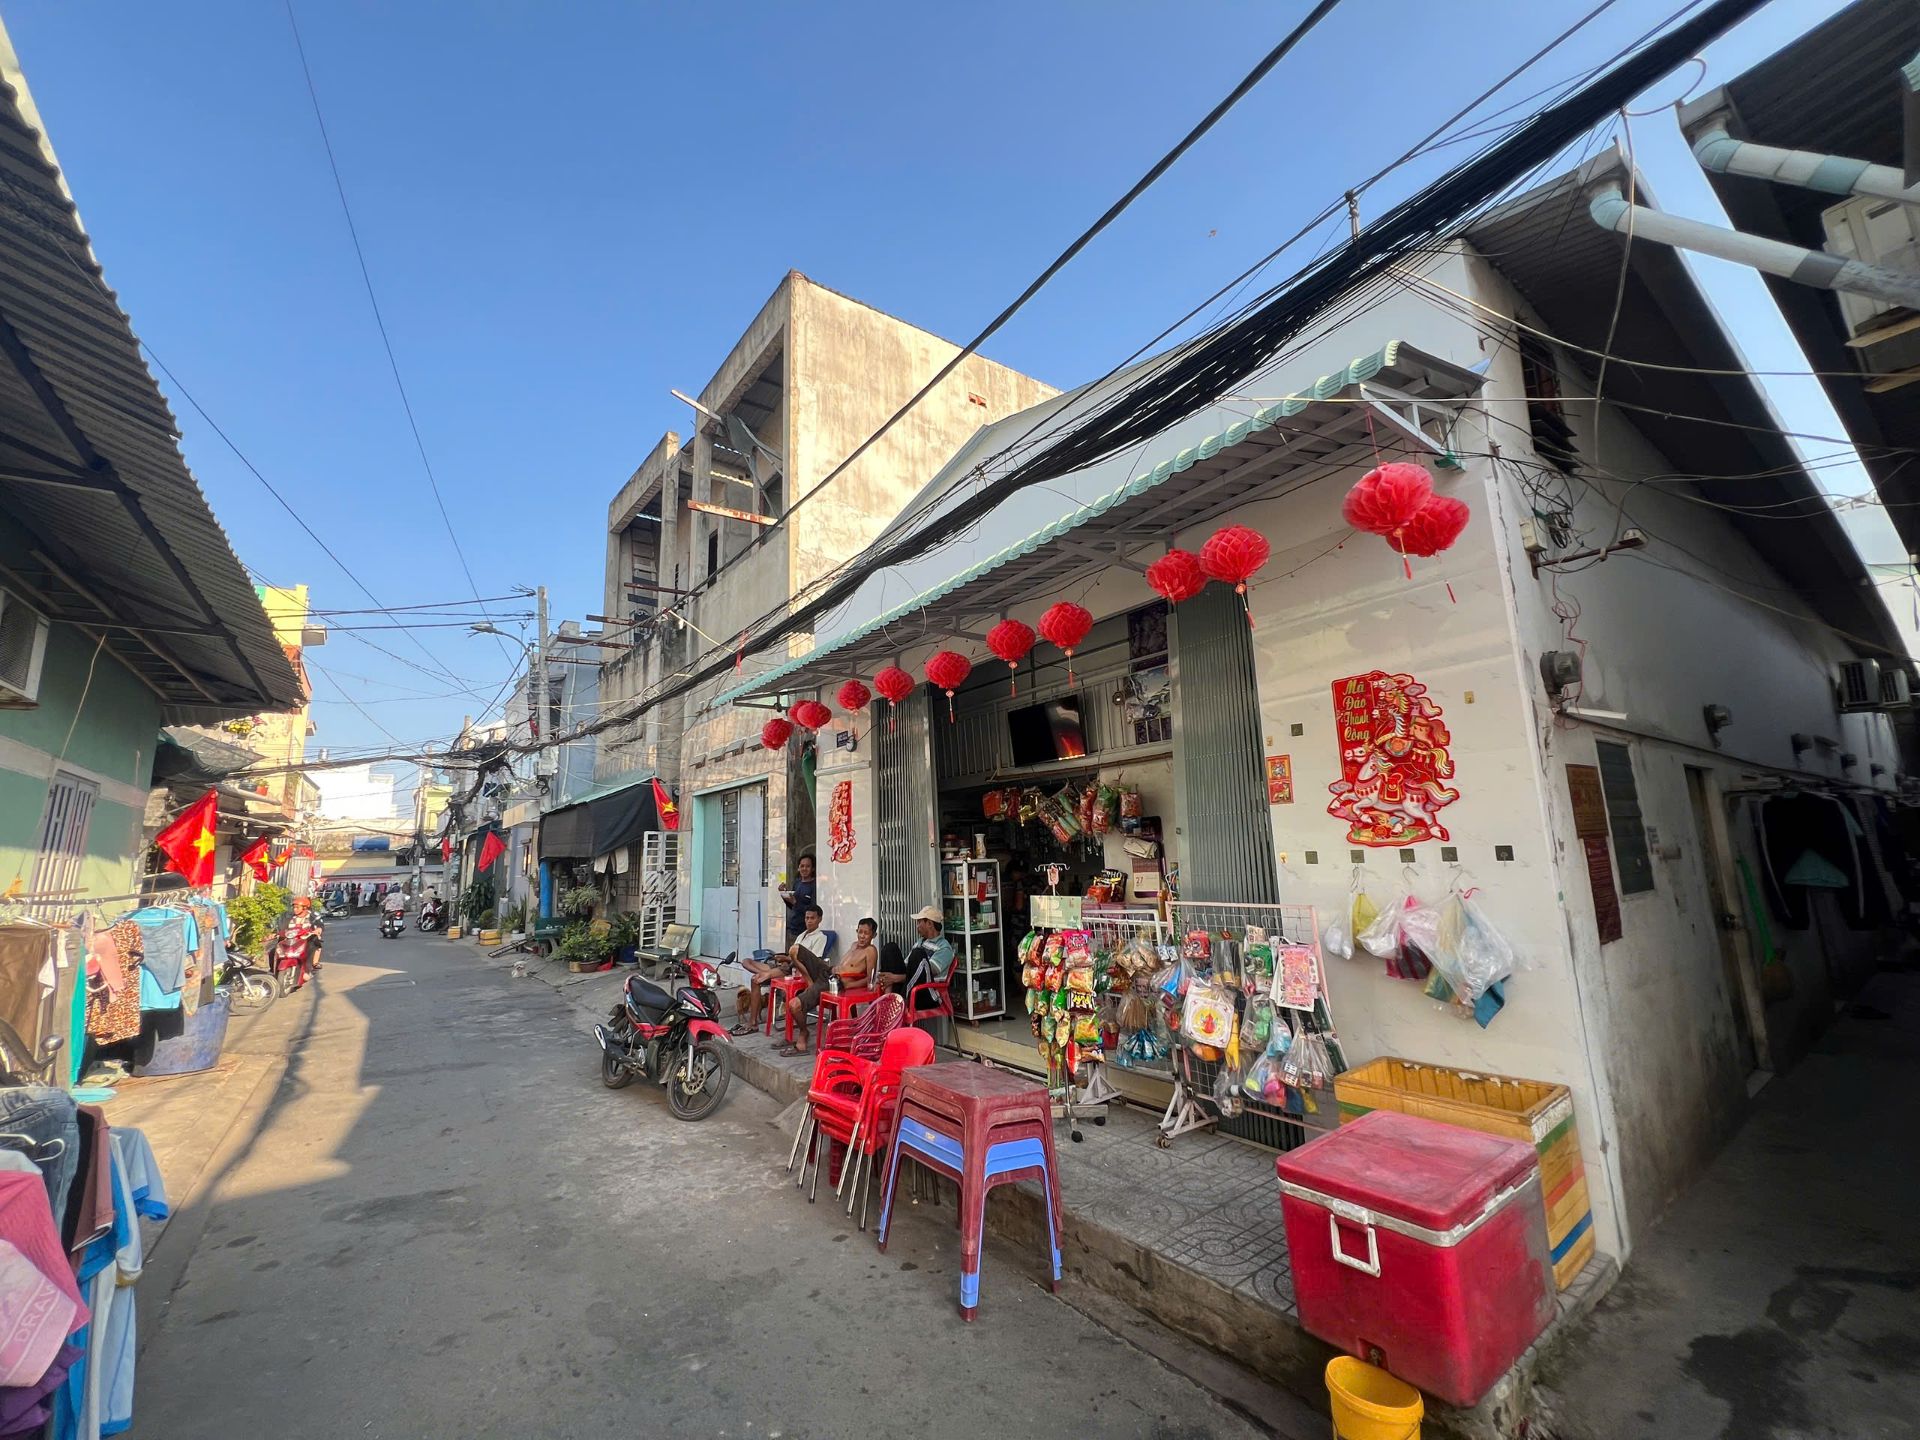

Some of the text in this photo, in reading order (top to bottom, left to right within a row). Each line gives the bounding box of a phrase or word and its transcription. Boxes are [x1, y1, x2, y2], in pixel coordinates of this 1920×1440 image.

[1342, 679, 1365, 696] Mã
[1343, 695, 1367, 711] Đáo
[1344, 726, 1370, 742] Công
